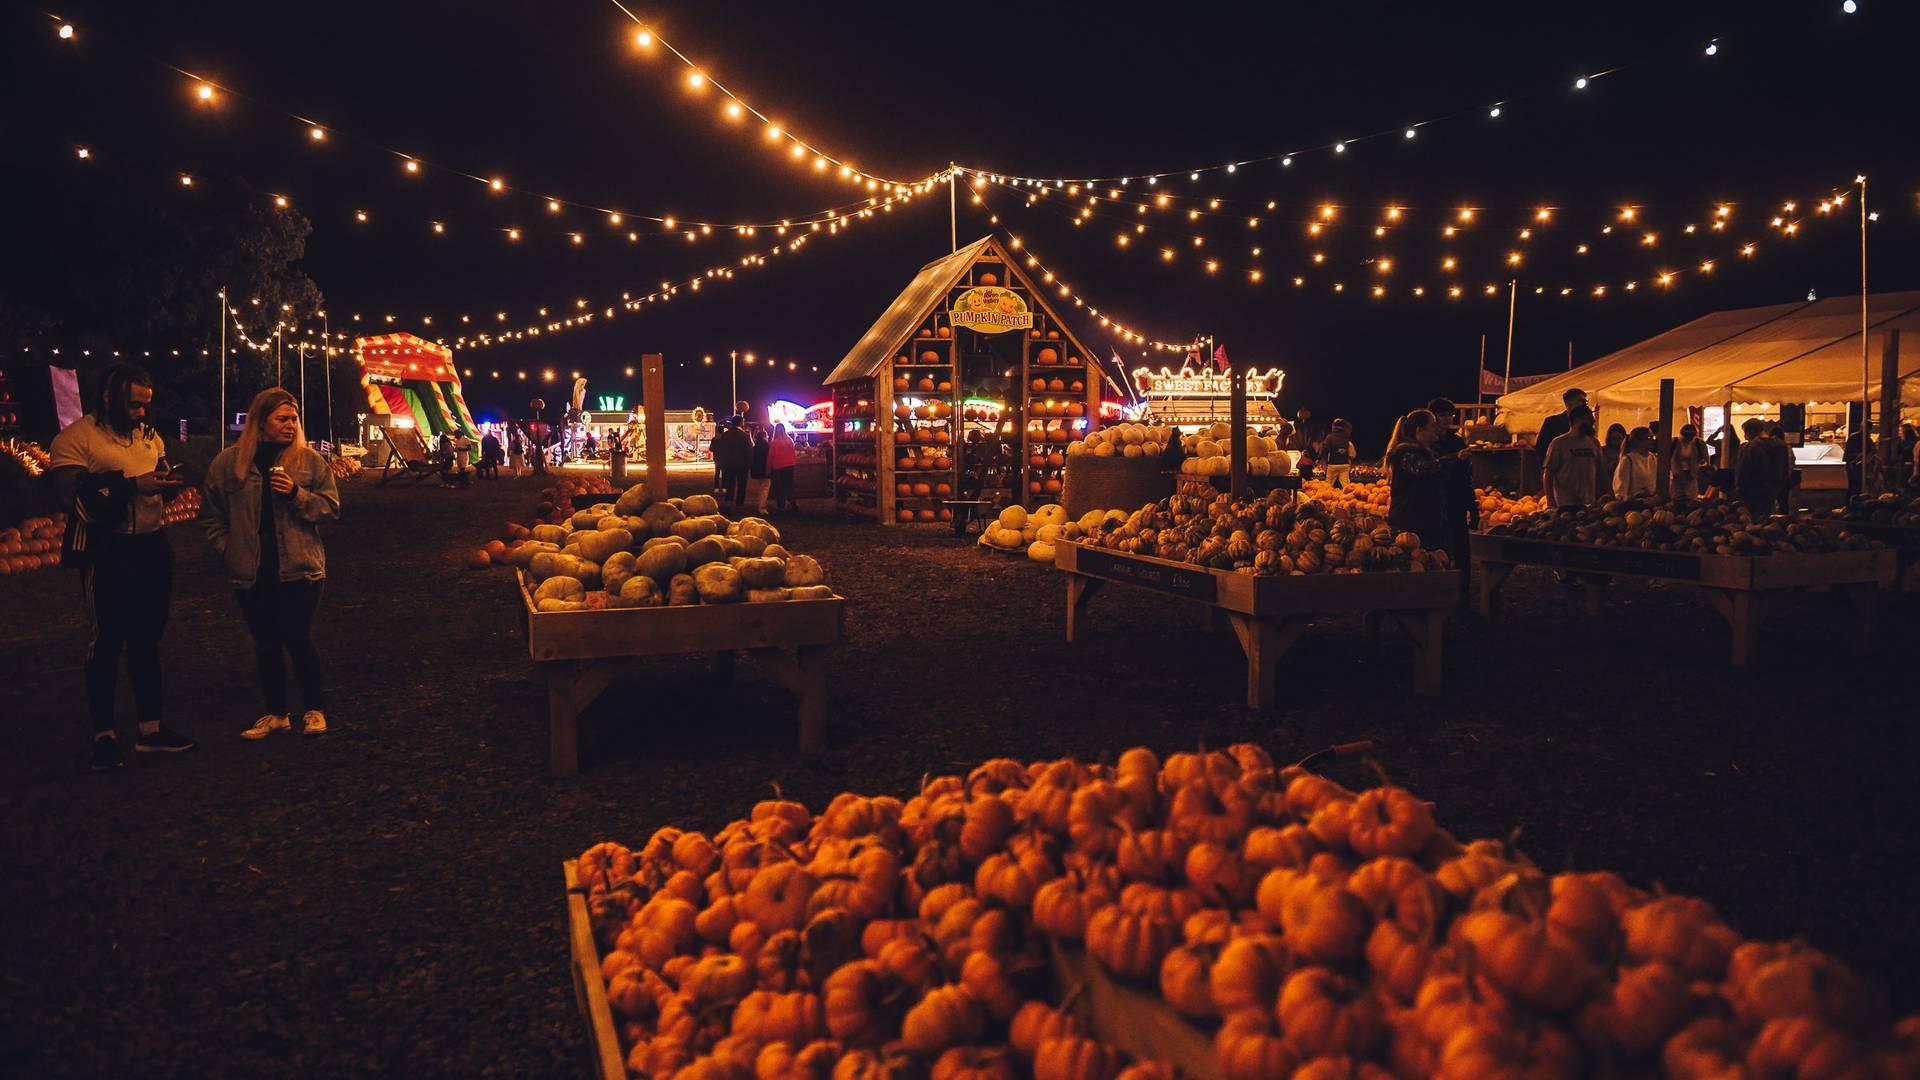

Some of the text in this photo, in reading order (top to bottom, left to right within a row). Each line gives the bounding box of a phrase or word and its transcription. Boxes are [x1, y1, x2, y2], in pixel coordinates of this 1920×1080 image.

[953, 311, 1029, 325] PUMPKIN PATCH
[1154, 380, 1263, 392] SWEET FACRY
